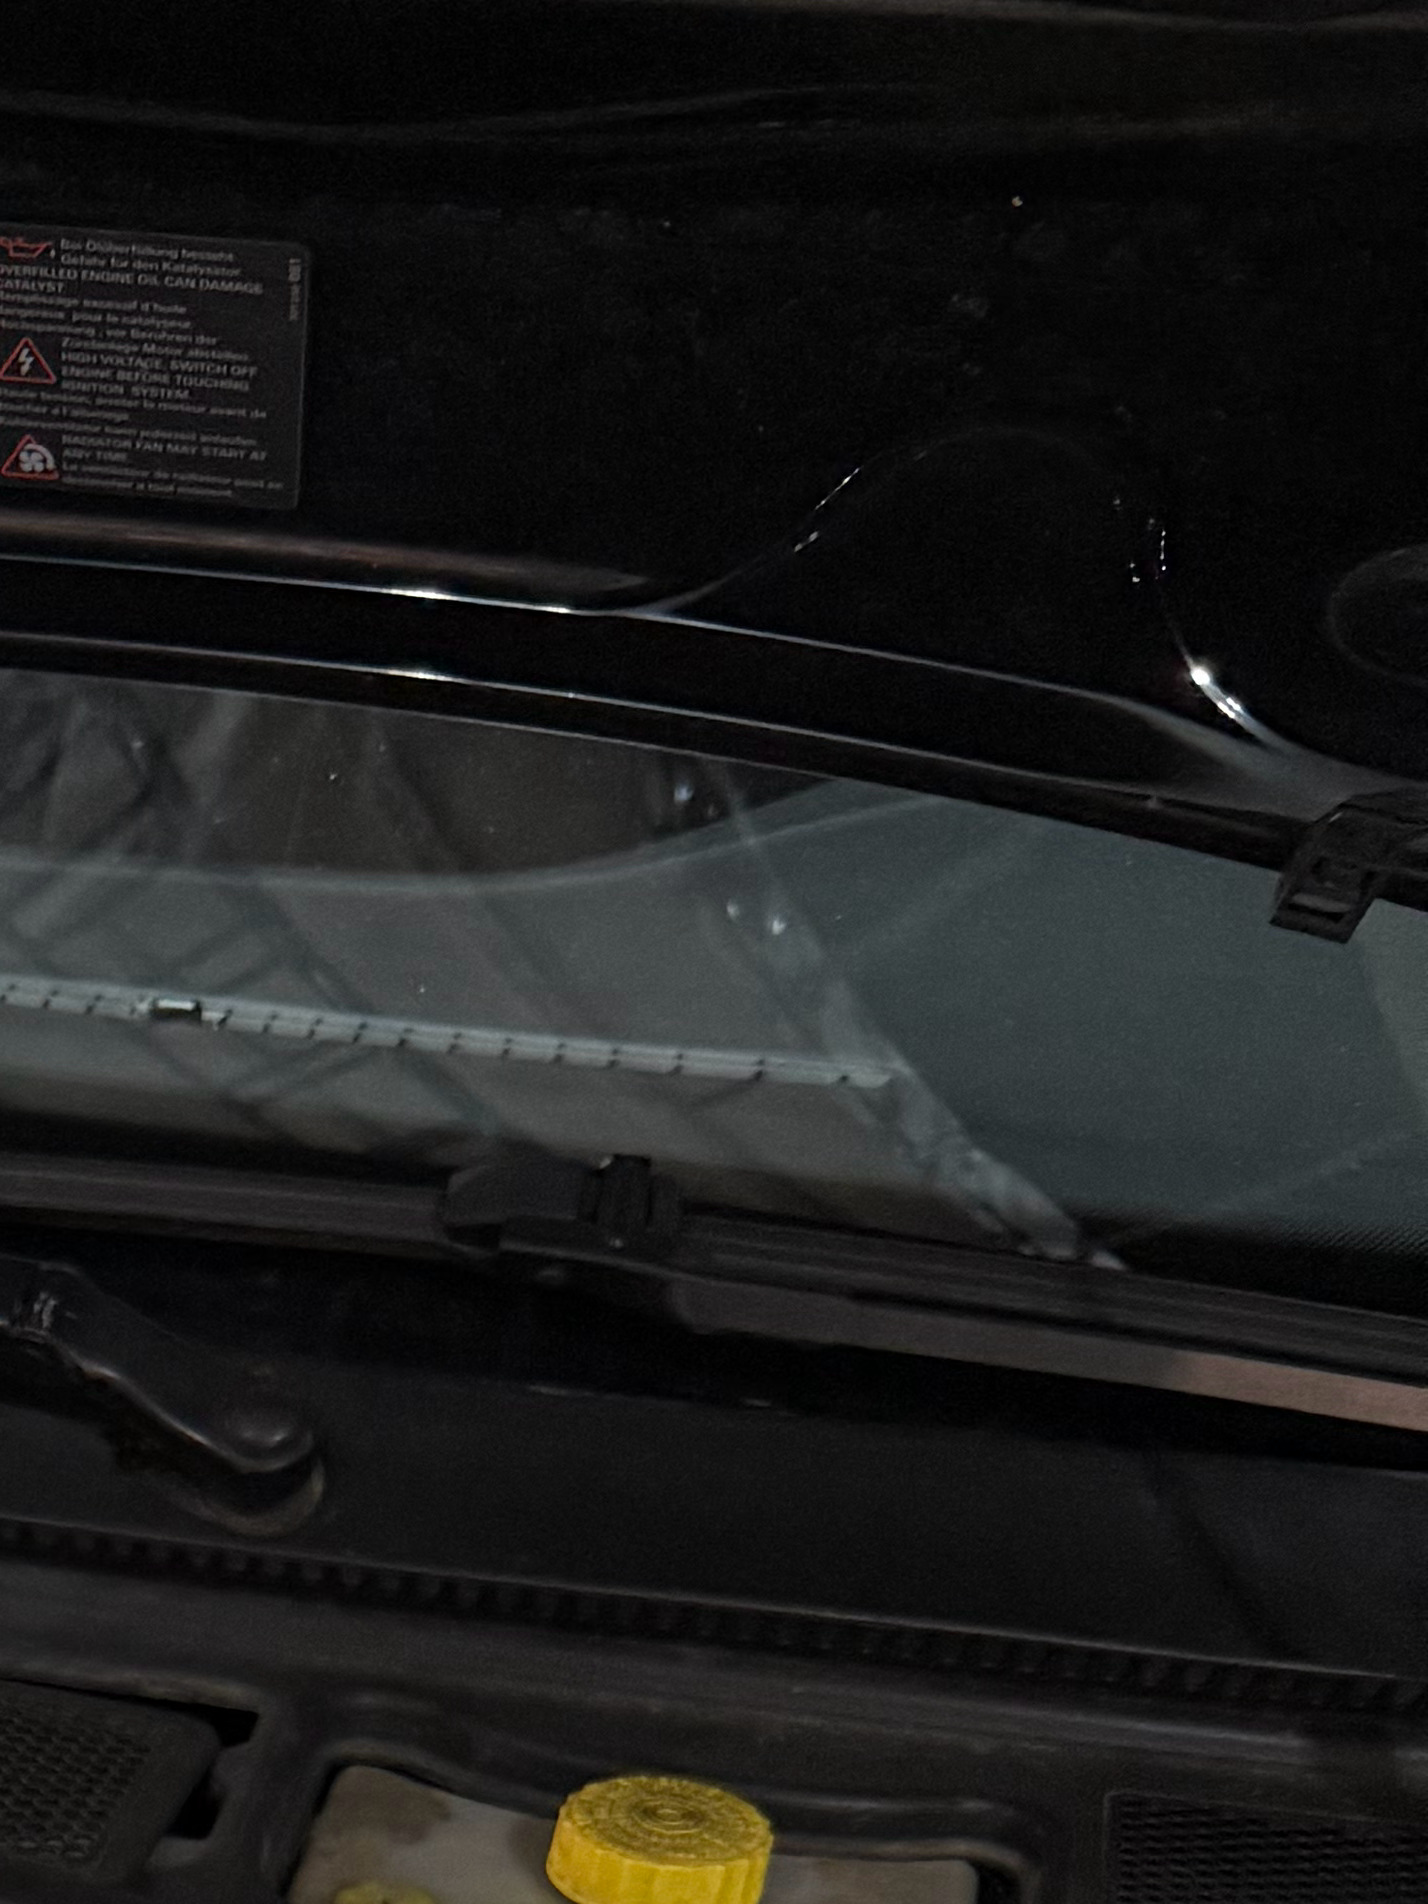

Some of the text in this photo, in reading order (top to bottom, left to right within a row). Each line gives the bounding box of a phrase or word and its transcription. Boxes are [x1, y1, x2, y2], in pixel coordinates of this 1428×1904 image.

[80, 269, 135, 284] ENGINE
[163, 276, 197, 290] CAN
[198, 278, 264, 295] DAMAGE
[60, 350, 99, 363] HIGH
[168, 359, 228, 376] SWITCH
[229, 364, 260, 379] OFF
[115, 368, 172, 384] BEFORE
[173, 374, 251, 392] TOUCHING
[134, 440, 164, 453] FAN
[165, 442, 200, 456] MAY
[200, 446, 246, 459] START
